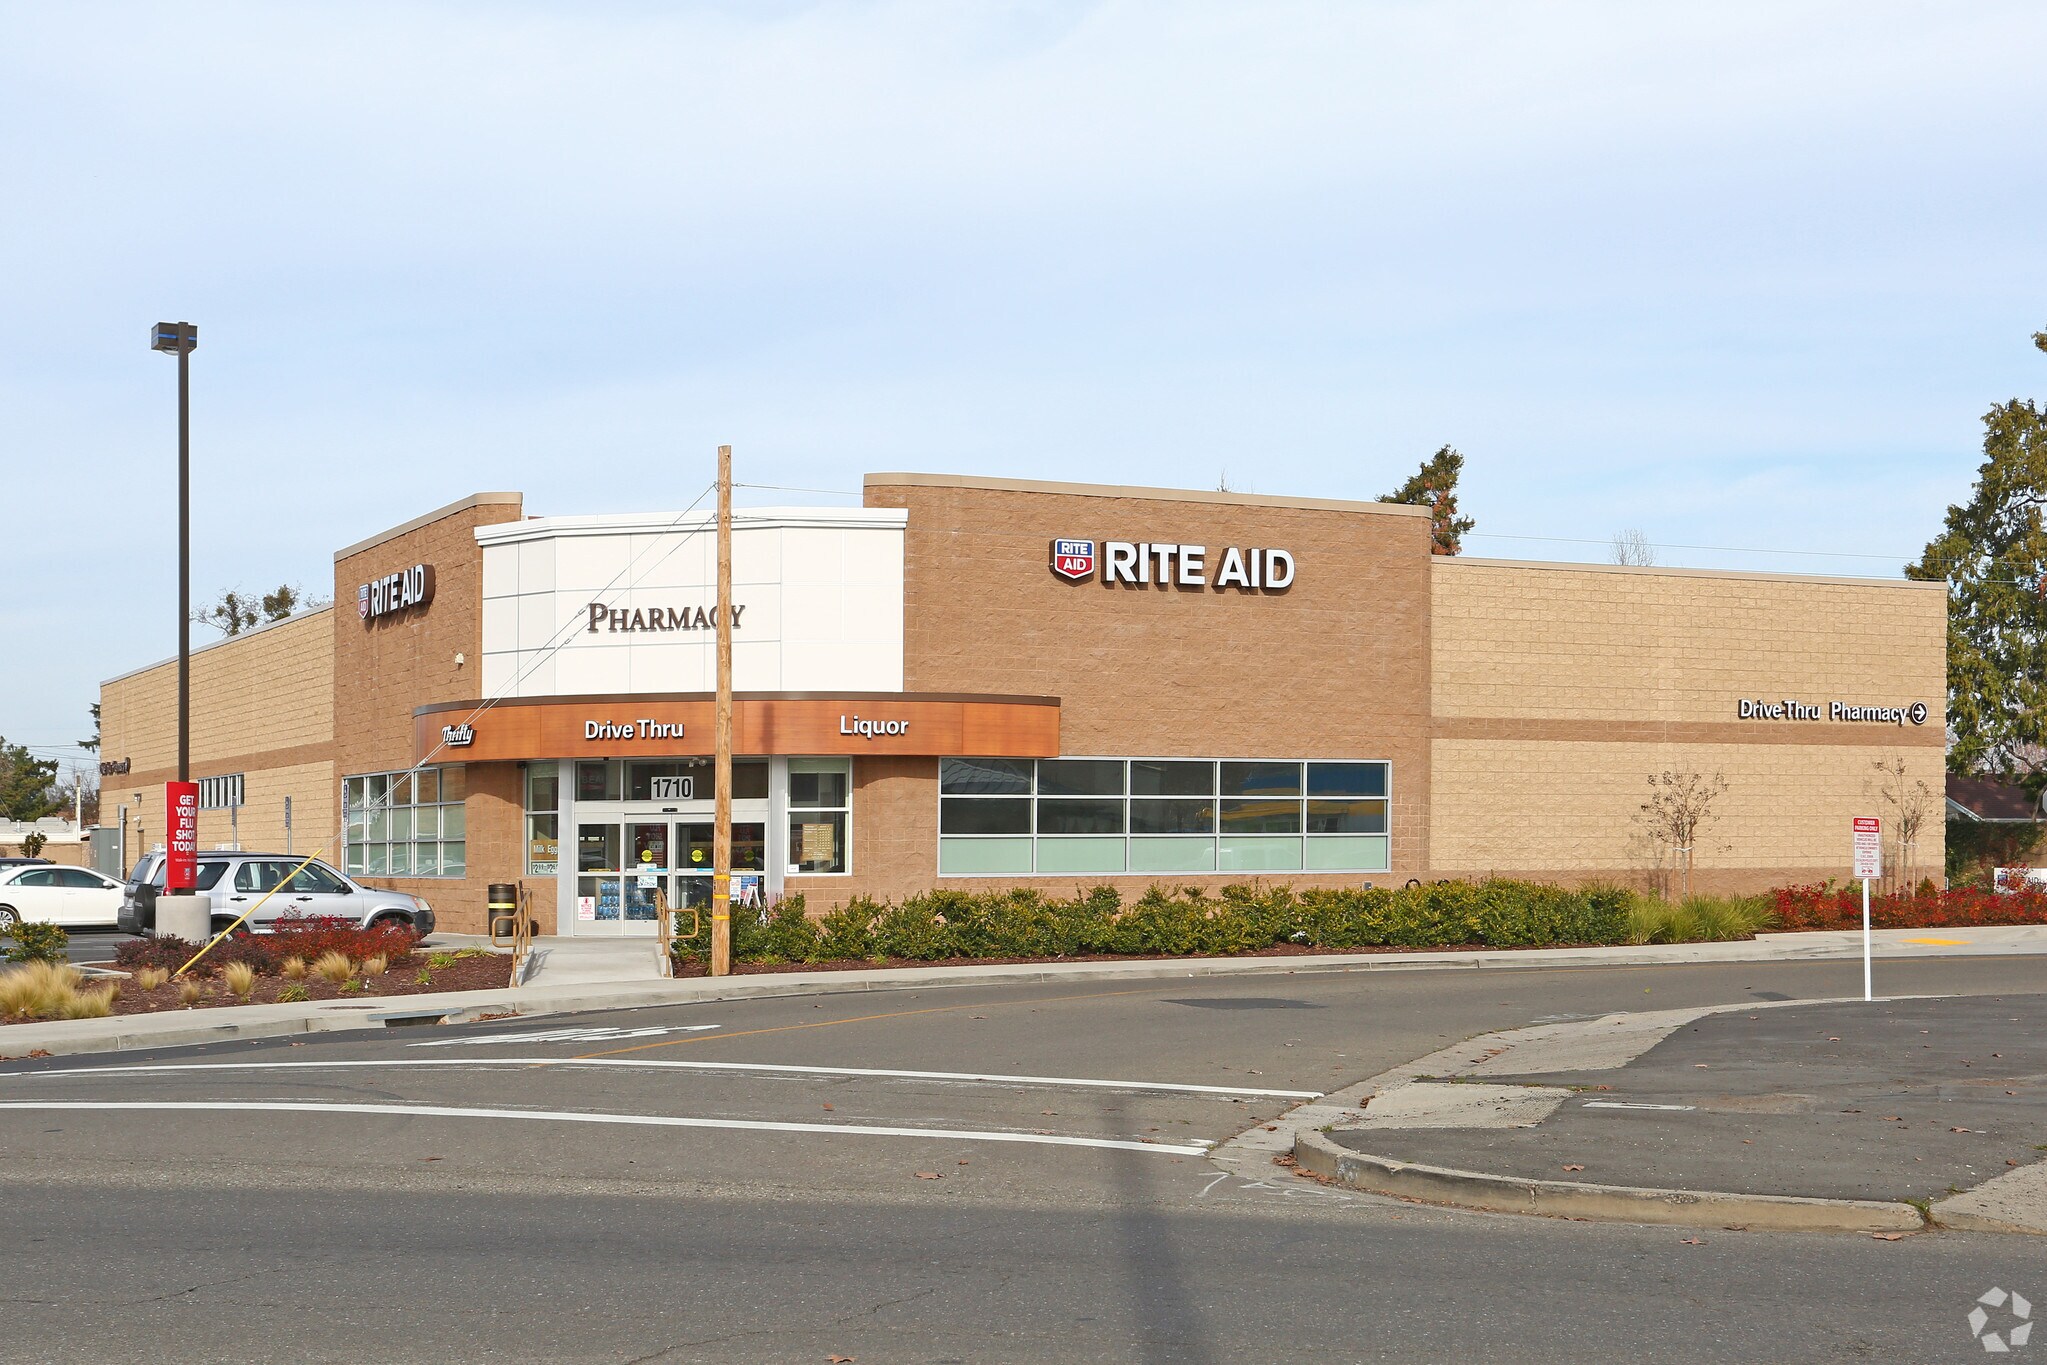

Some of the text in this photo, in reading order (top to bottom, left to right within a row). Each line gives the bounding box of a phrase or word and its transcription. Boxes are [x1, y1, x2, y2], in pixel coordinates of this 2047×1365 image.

[1061, 542, 1088, 555] RITE
[1063, 558, 1087, 571] AID
[1105, 541, 1296, 588] RITE AID
[371, 564, 425, 617] RITE AID
[1830, 701, 1910, 725] Pharmacy
[585, 719, 684, 739] Drive Thru
[840, 715, 909, 739] Liquor
[441, 723, 473, 745] Thrifty
[653, 778, 692, 798] 1710
[179, 795, 195, 806] GET
[175, 806, 196, 817] YOUR
[180, 818, 194, 829] FLU
[175, 830, 196, 840] SHOT
[172, 841, 196, 852] TODAY
[547, 844, 558, 855] Egg
